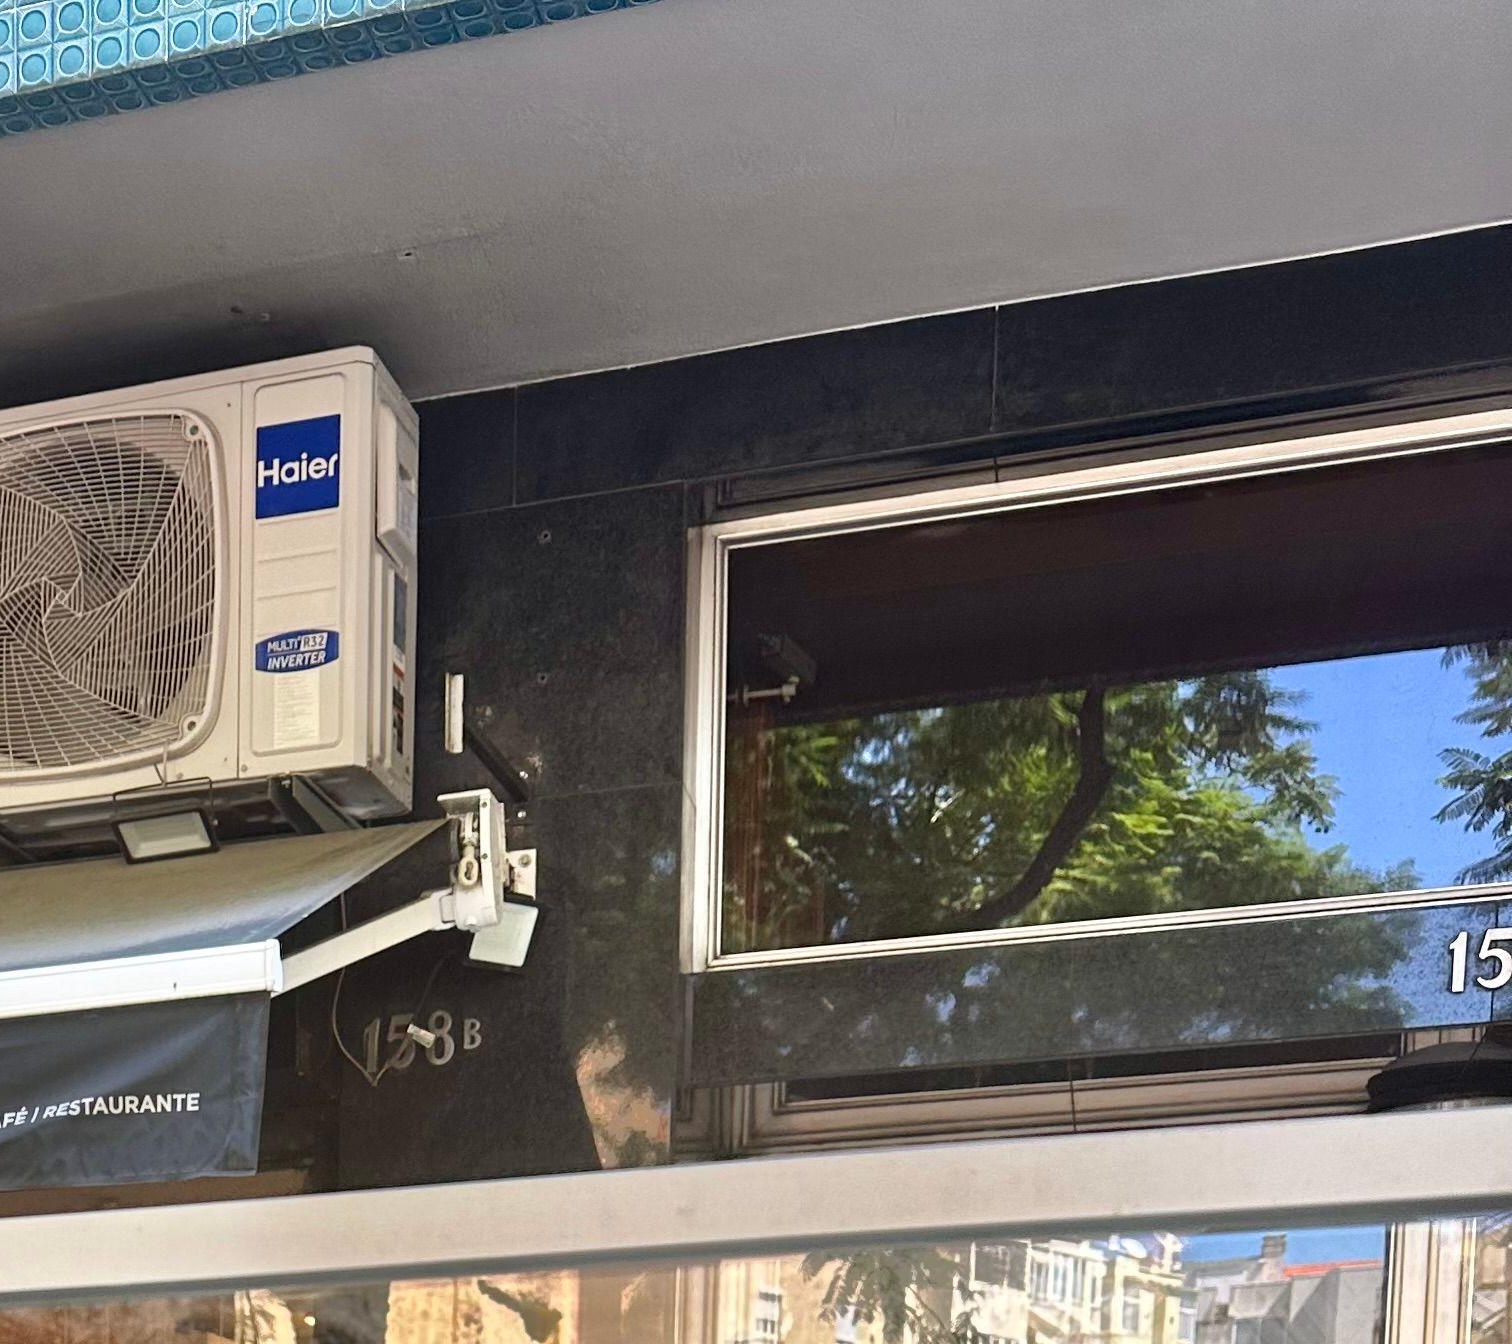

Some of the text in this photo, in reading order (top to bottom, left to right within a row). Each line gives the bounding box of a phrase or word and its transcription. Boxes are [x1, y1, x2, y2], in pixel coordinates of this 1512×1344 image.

[257, 452, 339, 488] Haier
[268, 650, 326, 670] INVERTER
[42, 1093, 201, 1120] RESTAURANTE
